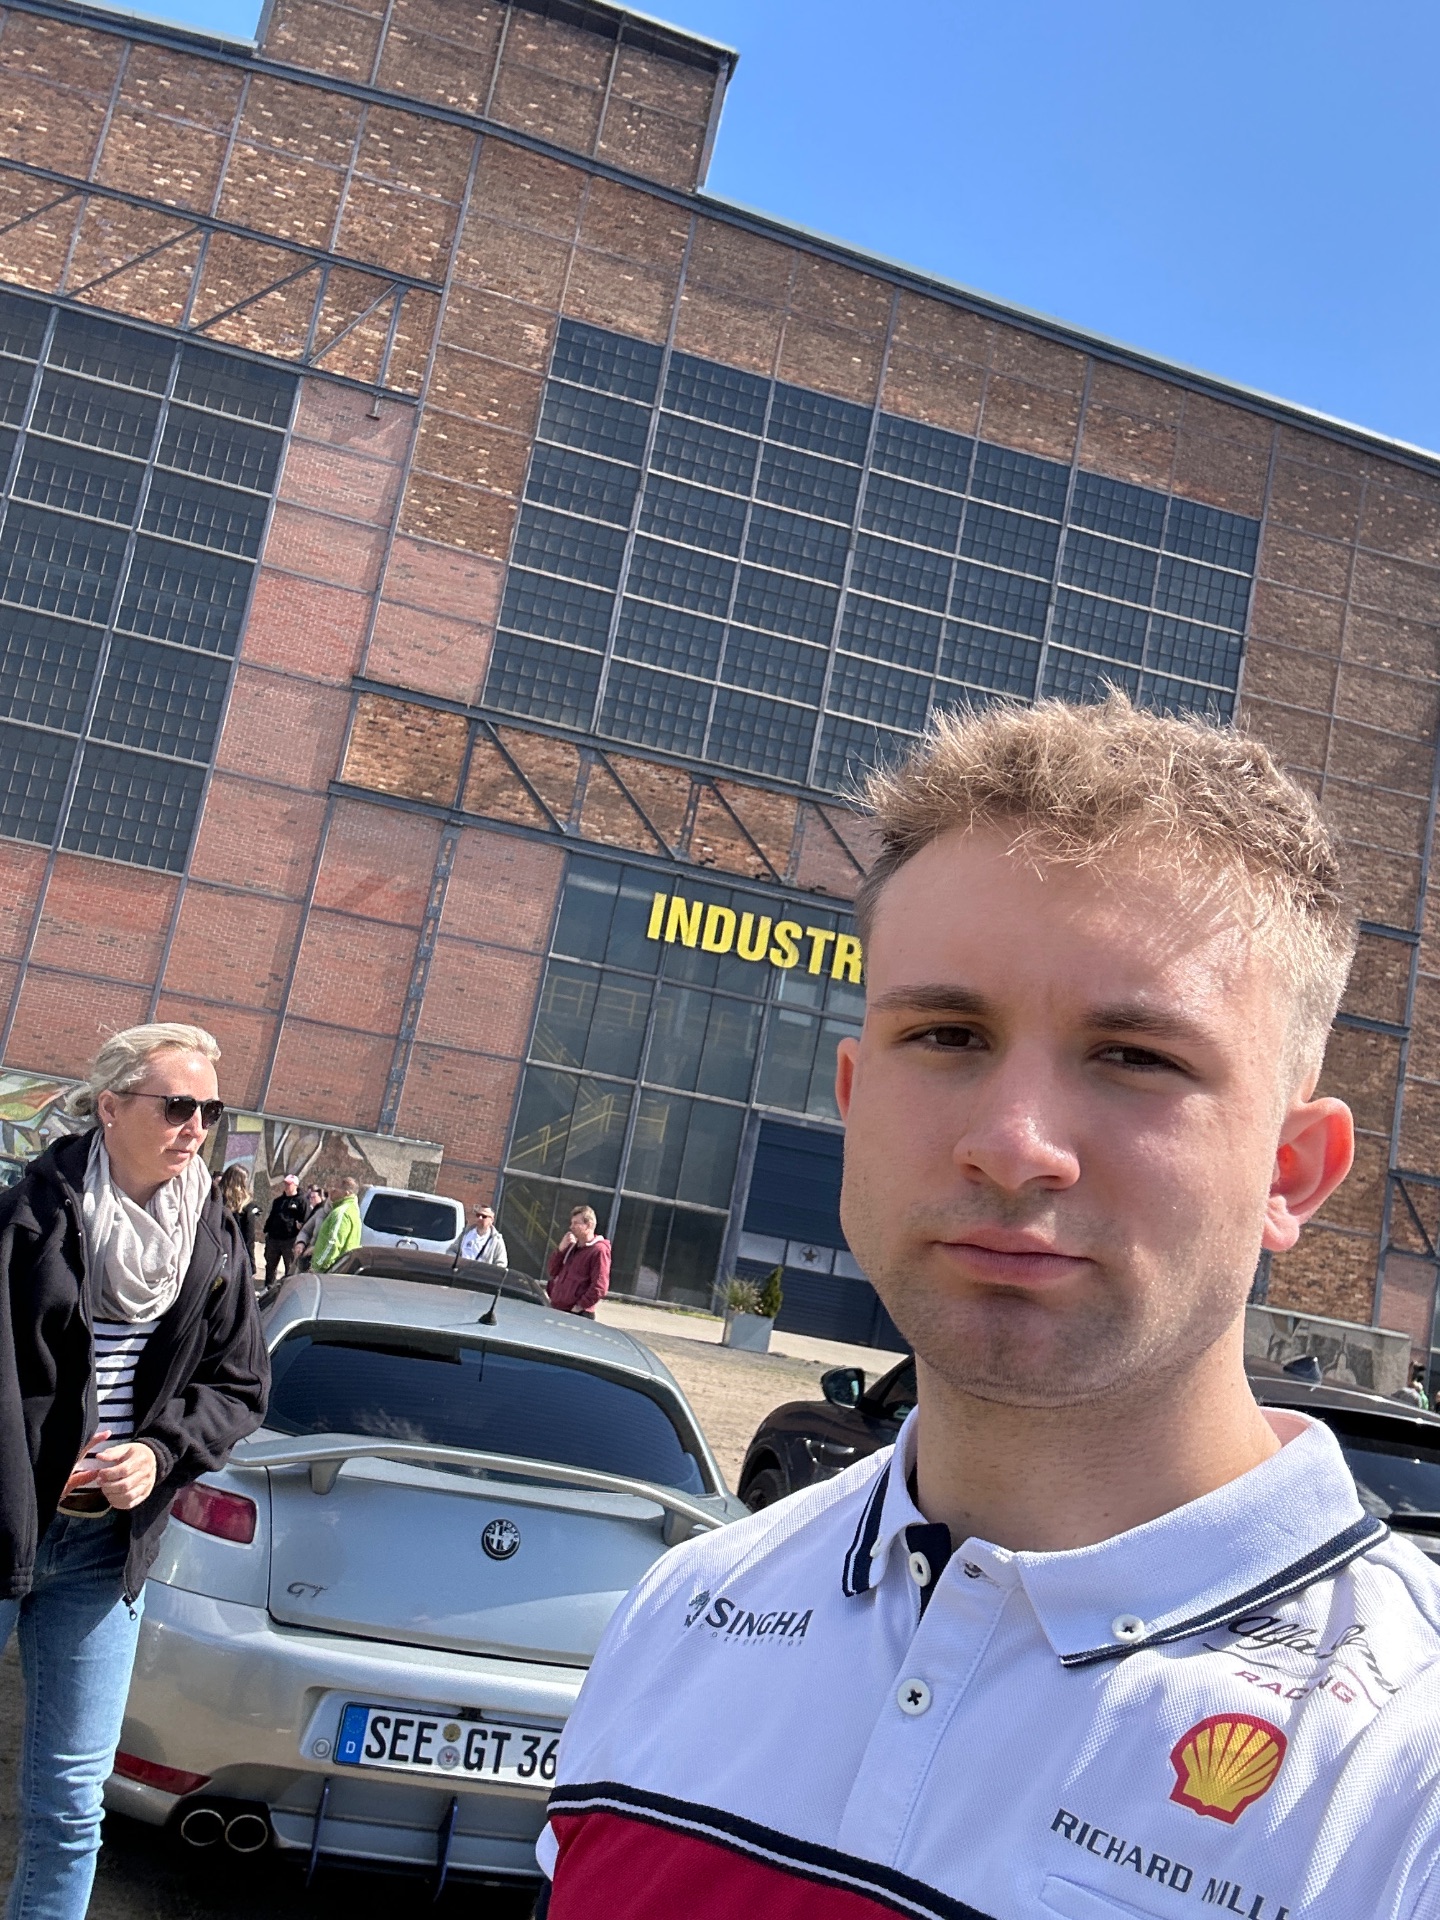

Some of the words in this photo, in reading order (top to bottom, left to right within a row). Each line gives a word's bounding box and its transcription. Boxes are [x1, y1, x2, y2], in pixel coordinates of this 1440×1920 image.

[1234, 1670, 1357, 1704] RACNG
[345, 1741, 356, 1754] D
[365, 1716, 438, 1765] SEE
[464, 1728, 512, 1774] GT
[1050, 1808, 1194, 1893] RICHARD
